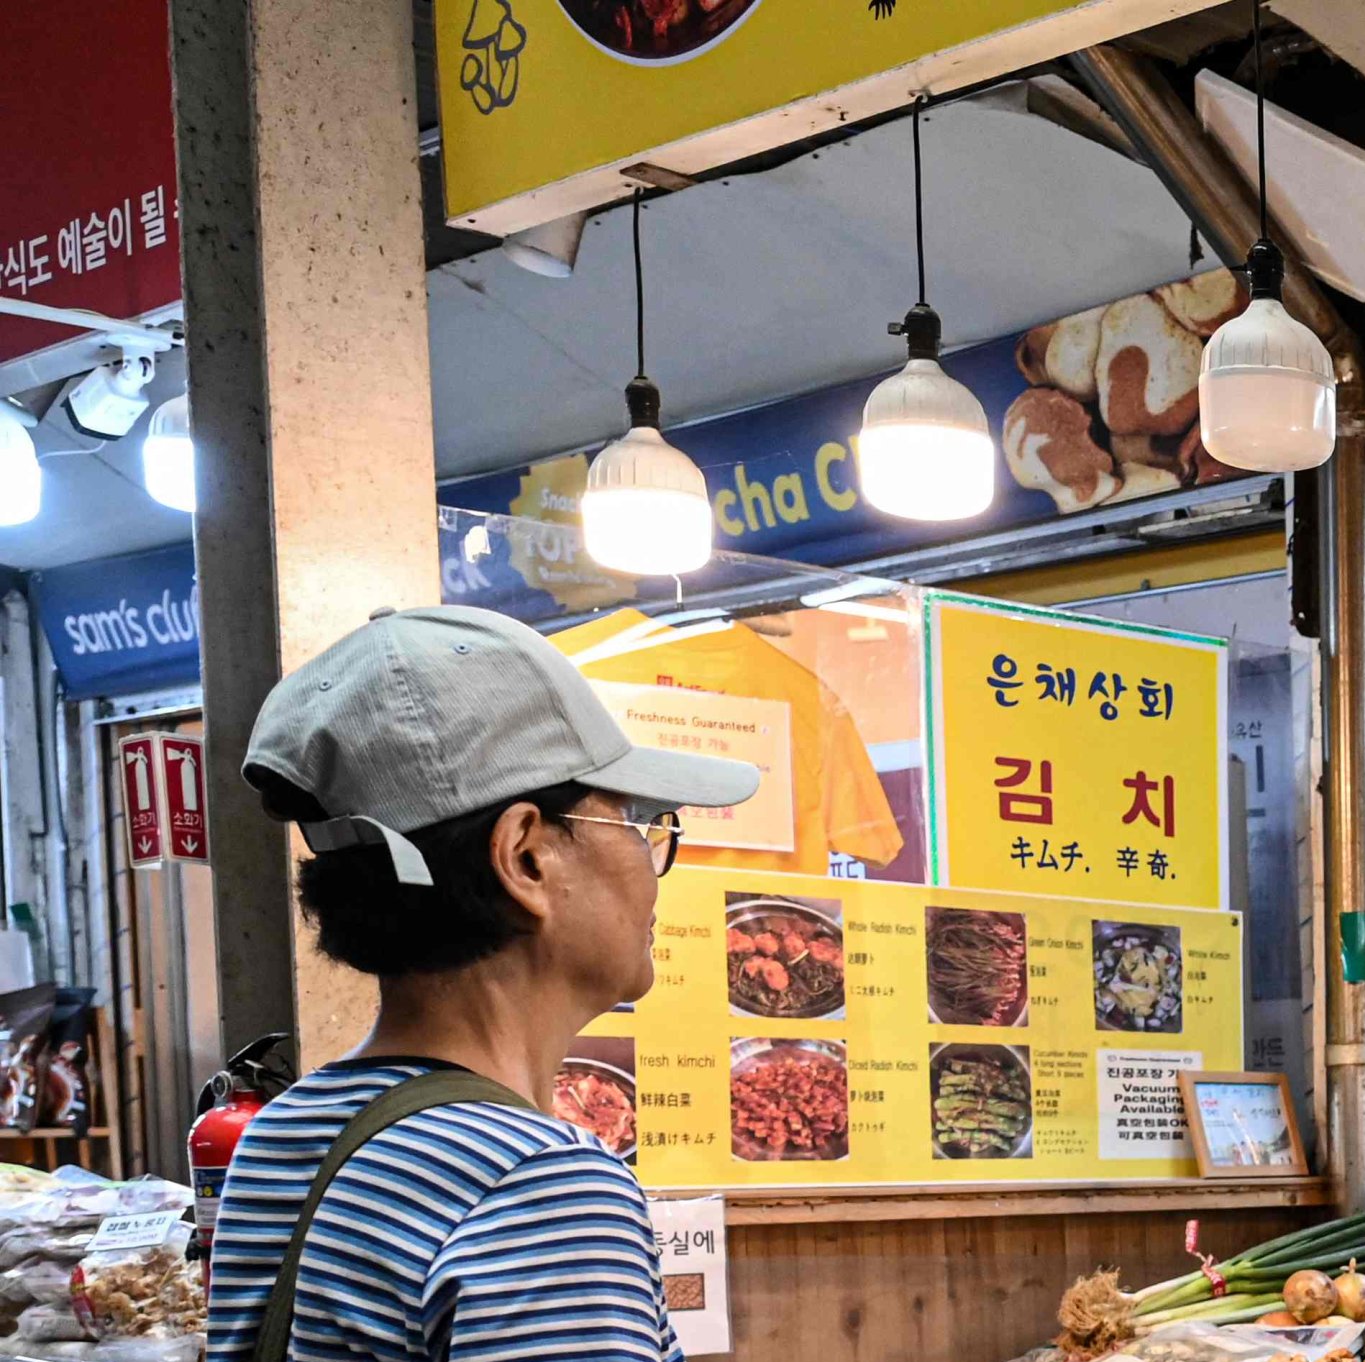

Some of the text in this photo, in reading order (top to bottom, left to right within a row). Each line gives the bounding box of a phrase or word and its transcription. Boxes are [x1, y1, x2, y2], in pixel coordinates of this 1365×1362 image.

[0, 184, 167, 295] 식도 예술이 될
[64, 599, 147, 656] sam's
[986, 653, 1174, 721] 은채상회
[626, 708, 756, 734] Freshness Guaranteed
[173, 811, 203, 827] 소화기
[639, 1053, 716, 1068] fresh kimchi
[1106, 1066, 1163, 1079] 진공포장
[1122, 1083, 1181, 1094] Vacuum
[1120, 1104, 1186, 1114] Available
